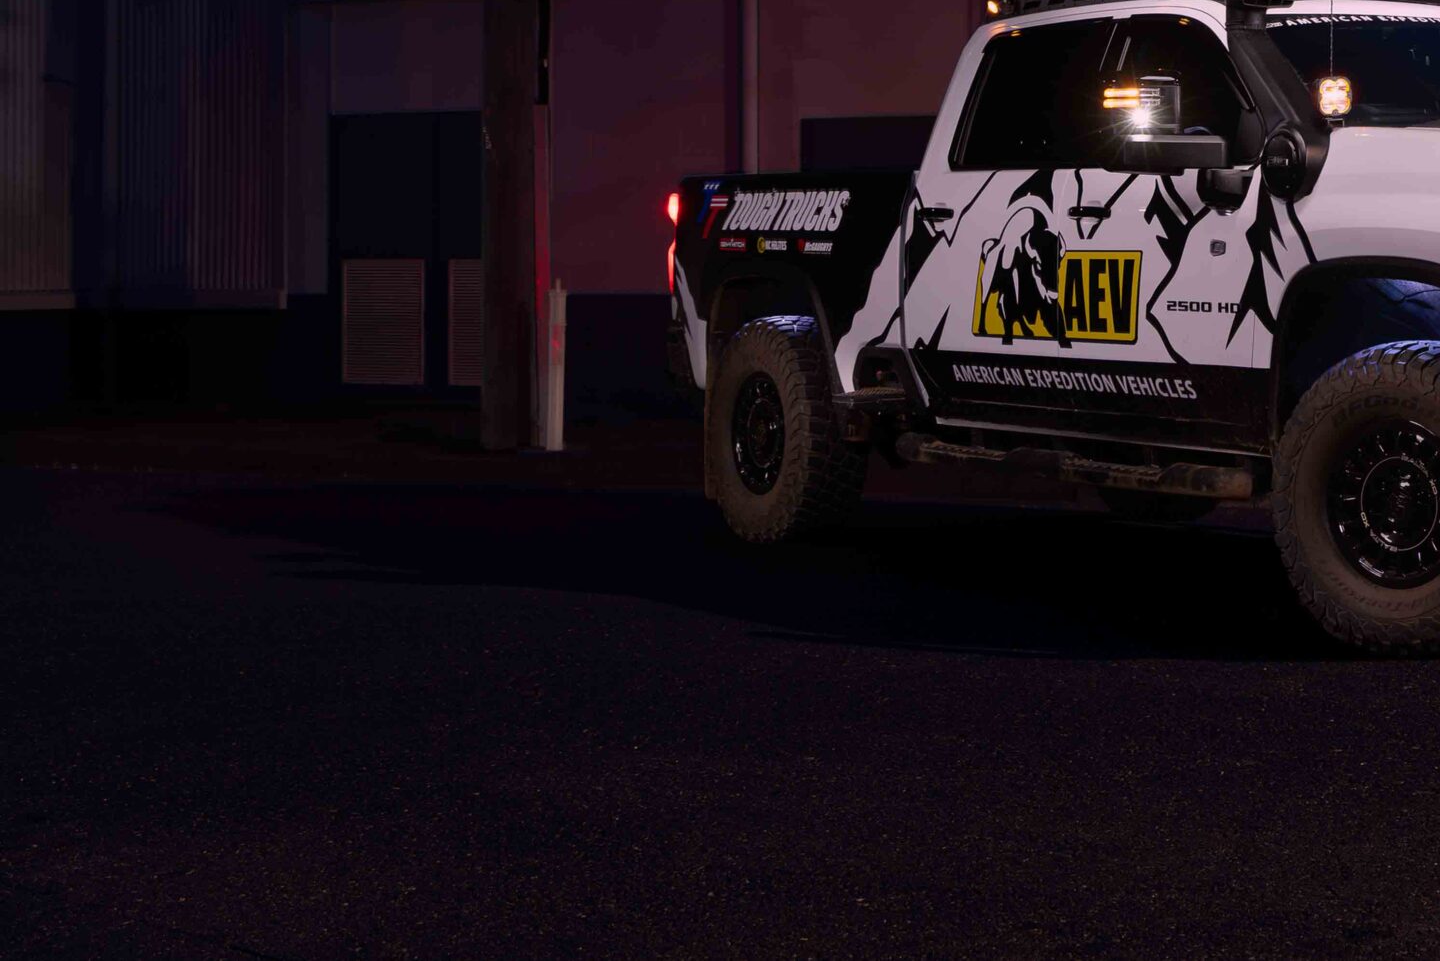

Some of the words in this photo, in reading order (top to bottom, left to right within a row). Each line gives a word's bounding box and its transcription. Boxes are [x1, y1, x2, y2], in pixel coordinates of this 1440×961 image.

[1286, 15, 1373, 27] AMERICAN
[722, 190, 784, 231] TOUGH
[779, 190, 850, 231] TRUCKS
[1063, 258, 1136, 334] AEV
[1166, 300, 1211, 313] 2500
[1218, 301, 1242, 314] HD
[952, 364, 1024, 388] AMERICAN
[1025, 369, 1115, 394] EXPEDITION
[1119, 375, 1198, 400] VEHICLES
